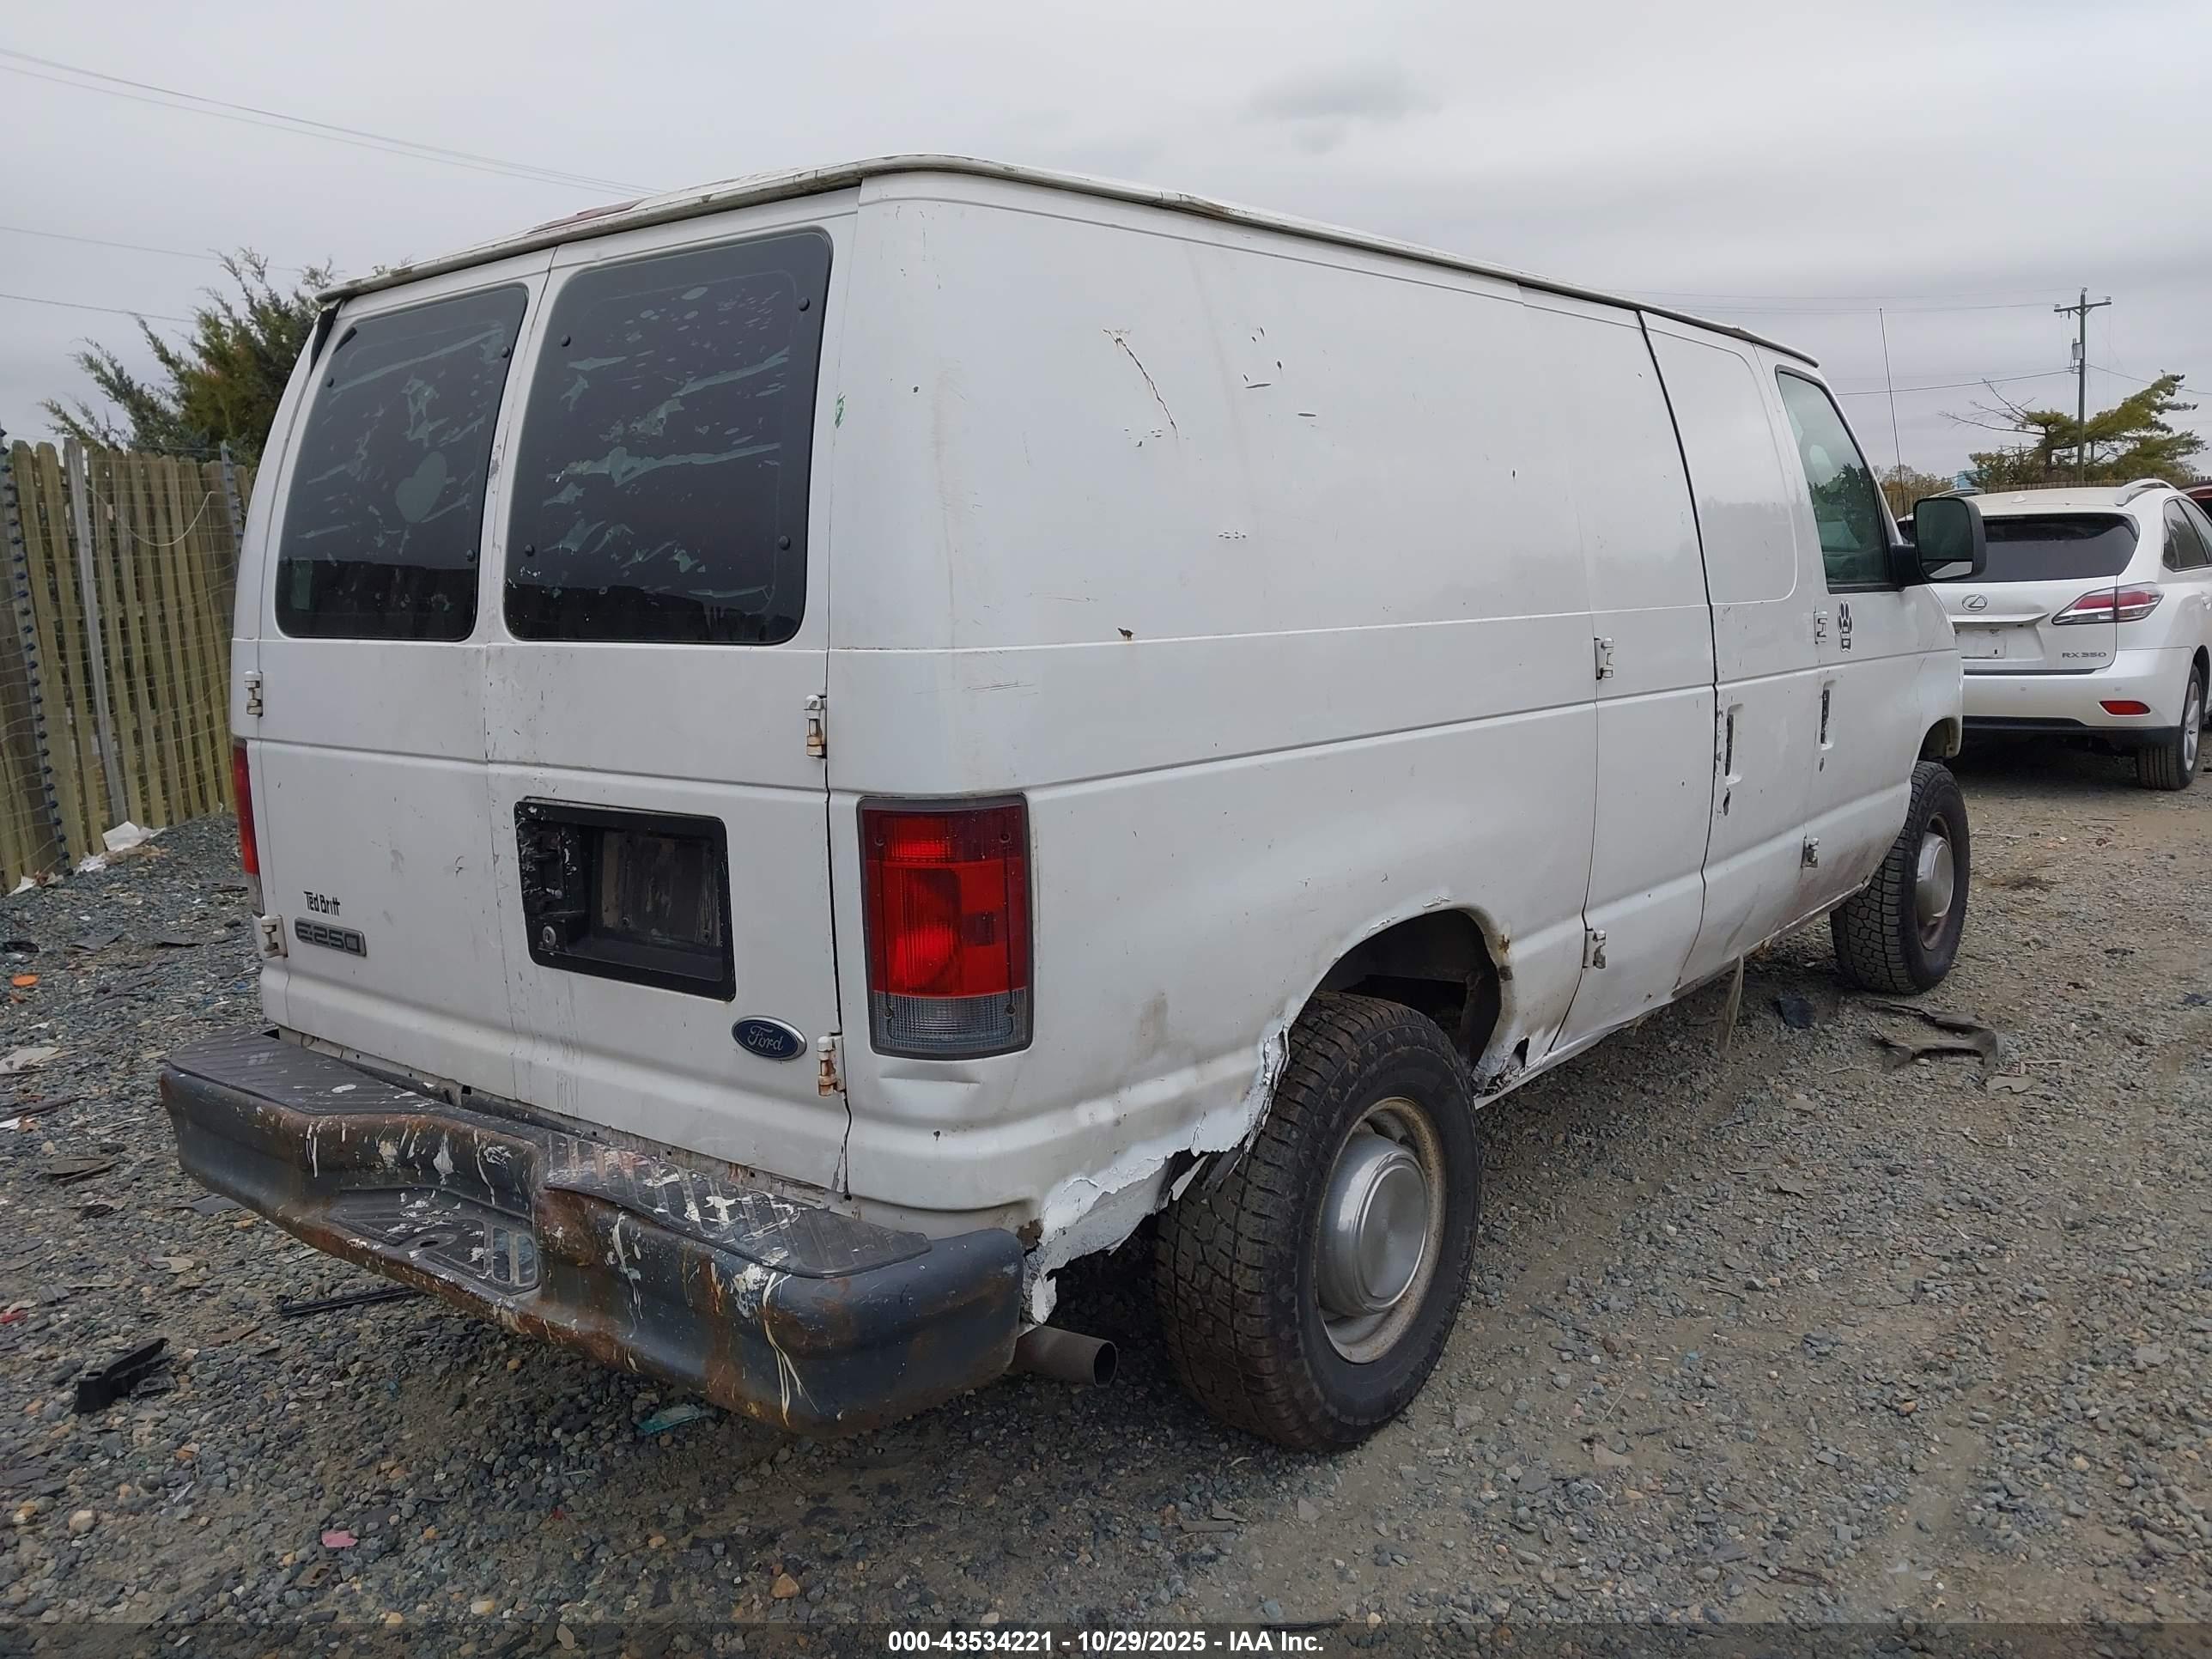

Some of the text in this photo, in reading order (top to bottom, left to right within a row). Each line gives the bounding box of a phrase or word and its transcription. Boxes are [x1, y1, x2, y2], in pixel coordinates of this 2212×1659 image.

[303, 890, 341, 916] Ted Britt
[747, 1025, 784, 1051] Ford
